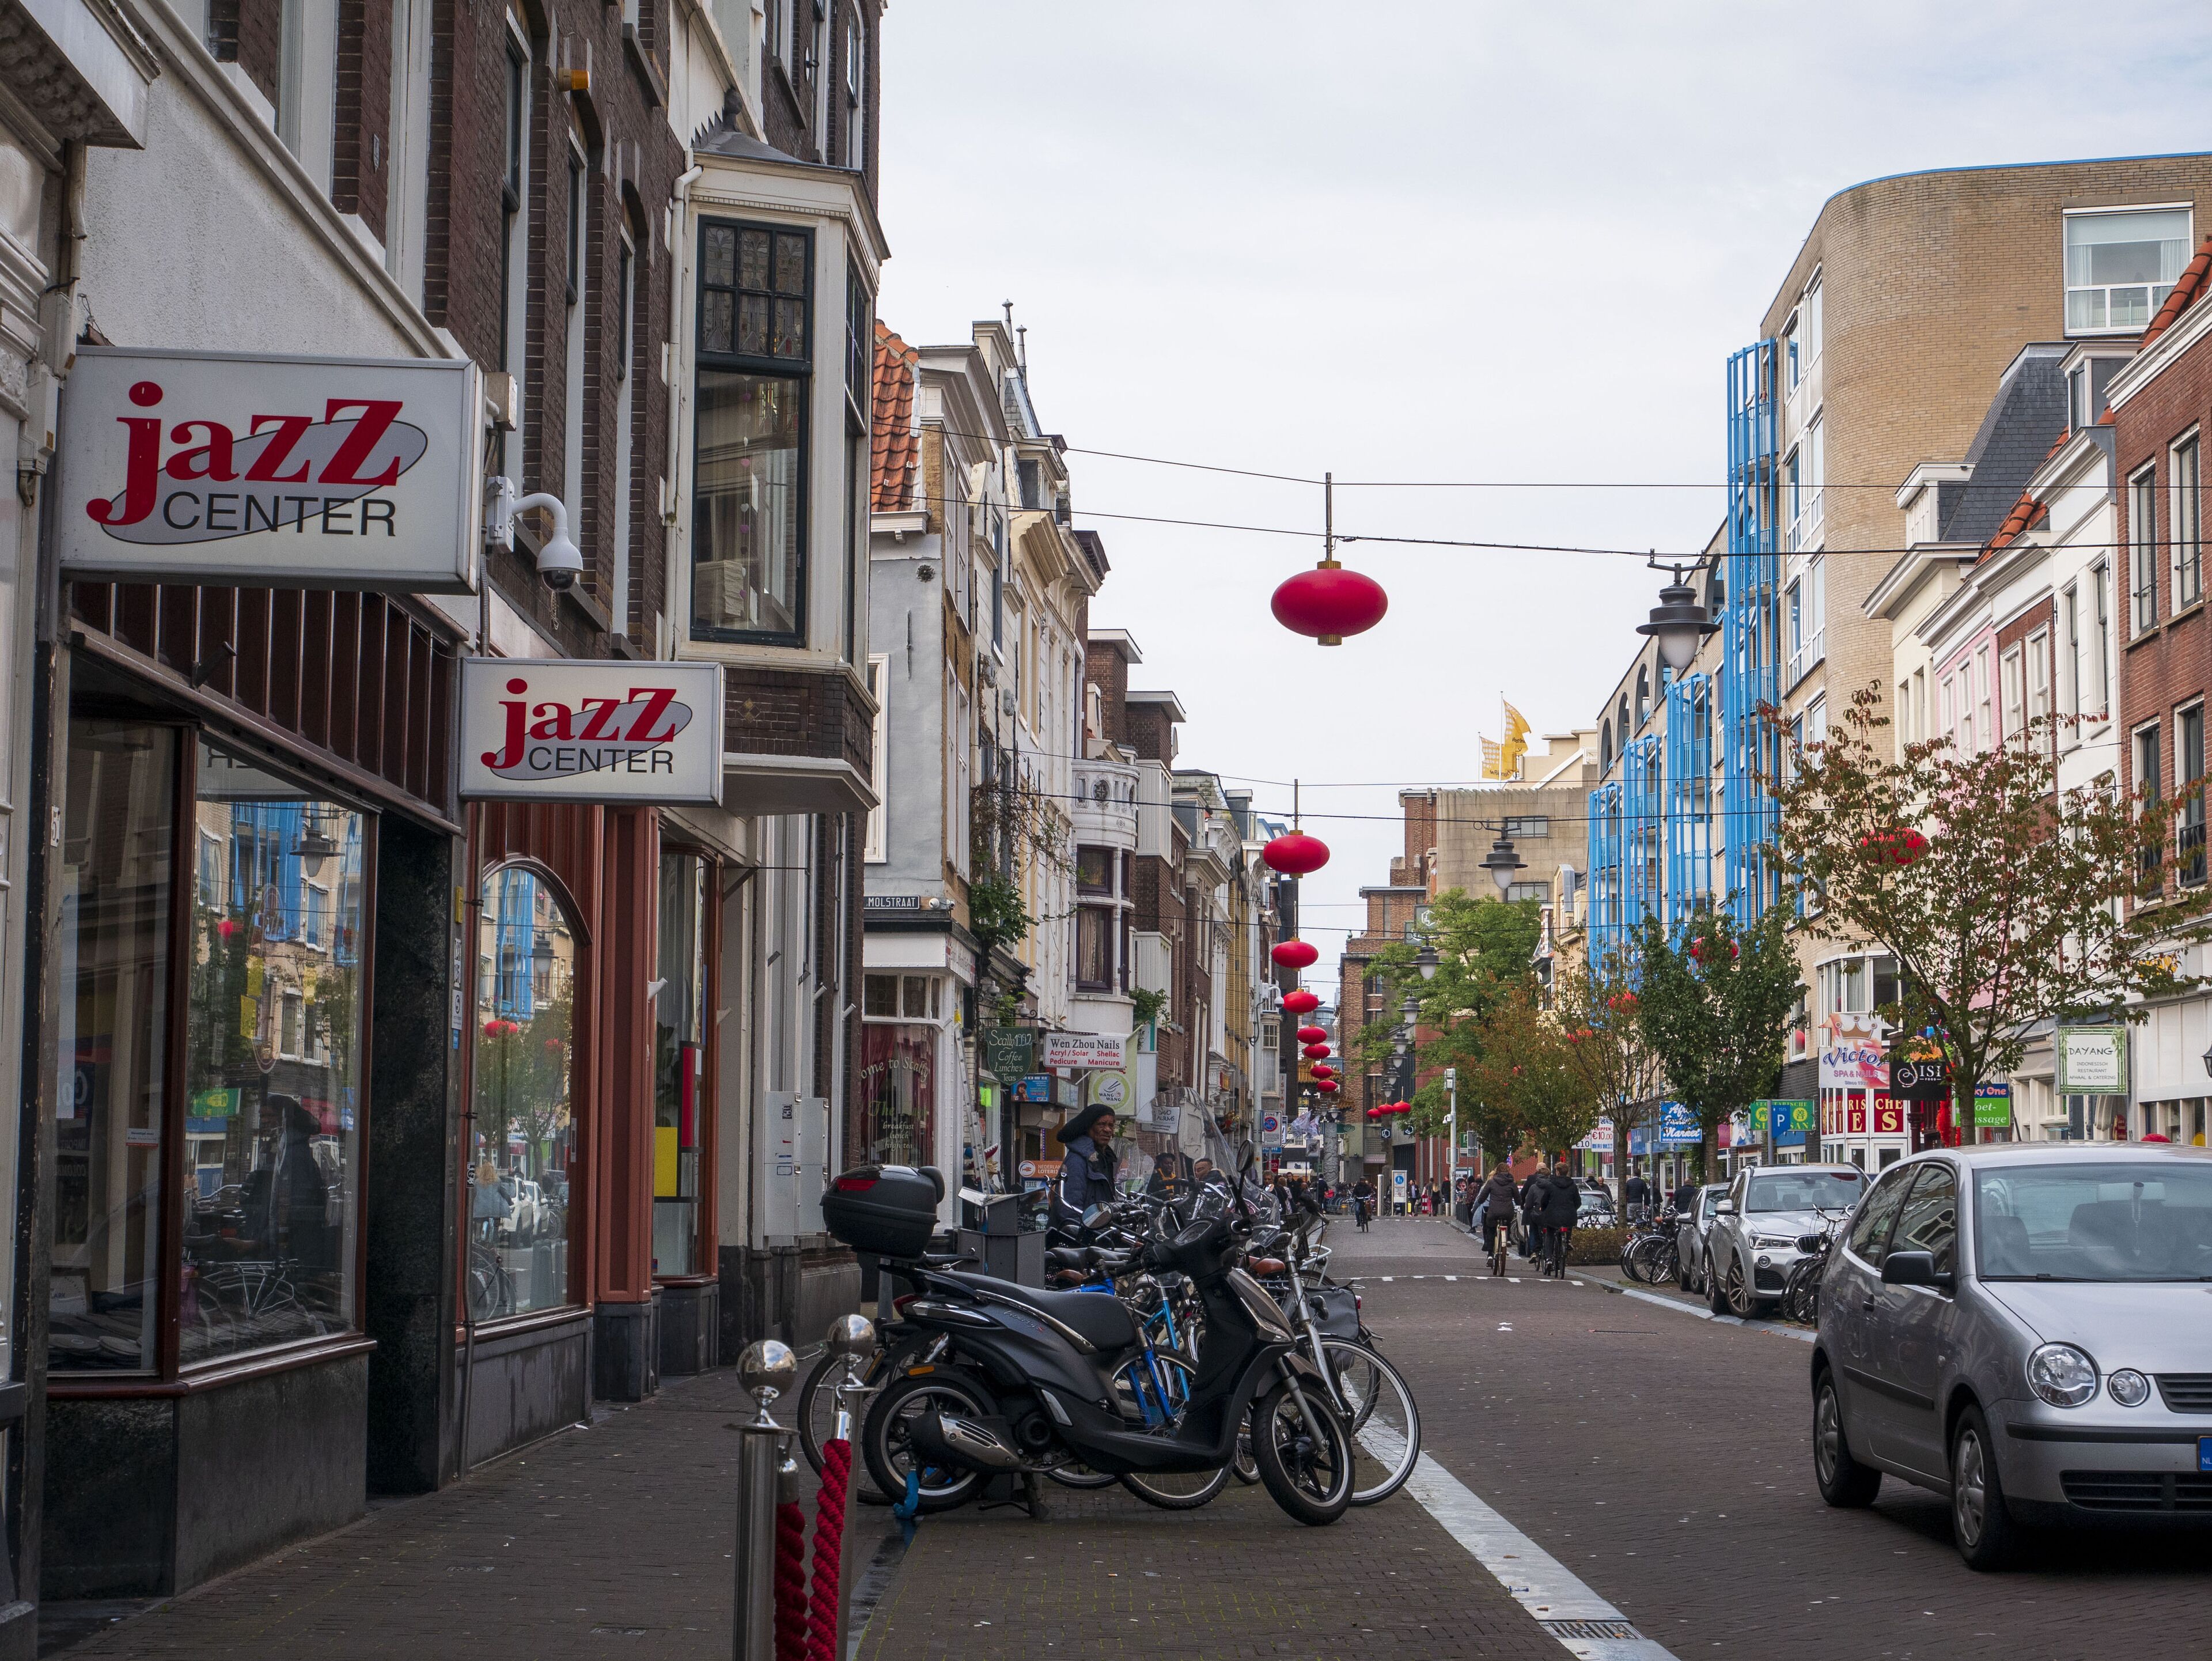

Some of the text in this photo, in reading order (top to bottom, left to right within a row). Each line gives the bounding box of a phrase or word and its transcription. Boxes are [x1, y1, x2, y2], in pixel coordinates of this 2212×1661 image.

[163, 491, 396, 537] CENTER
[528, 747, 673, 774] CENTER
[868, 897, 916, 907] MOLSTRAAT
[989, 1030, 1032, 1050] Scally 1992
[1051, 1039, 1120, 1050] Wen Zhou Nails
[2069, 1047, 2113, 1055] DAYANG
[998, 1050, 1022, 1065] Coffee
[861, 1061, 884, 1079] ome
[994, 1063, 1024, 1072] Lunches
[1002, 1073, 1016, 1082] Teas
[1834, 1070, 1849, 1078] SPA
[1856, 1070, 1878, 1079] NAILS
[1986, 1087, 2007, 1095] One
[1777, 1114, 1785, 1127] P
[1975, 1117, 2007, 1125] ssage
